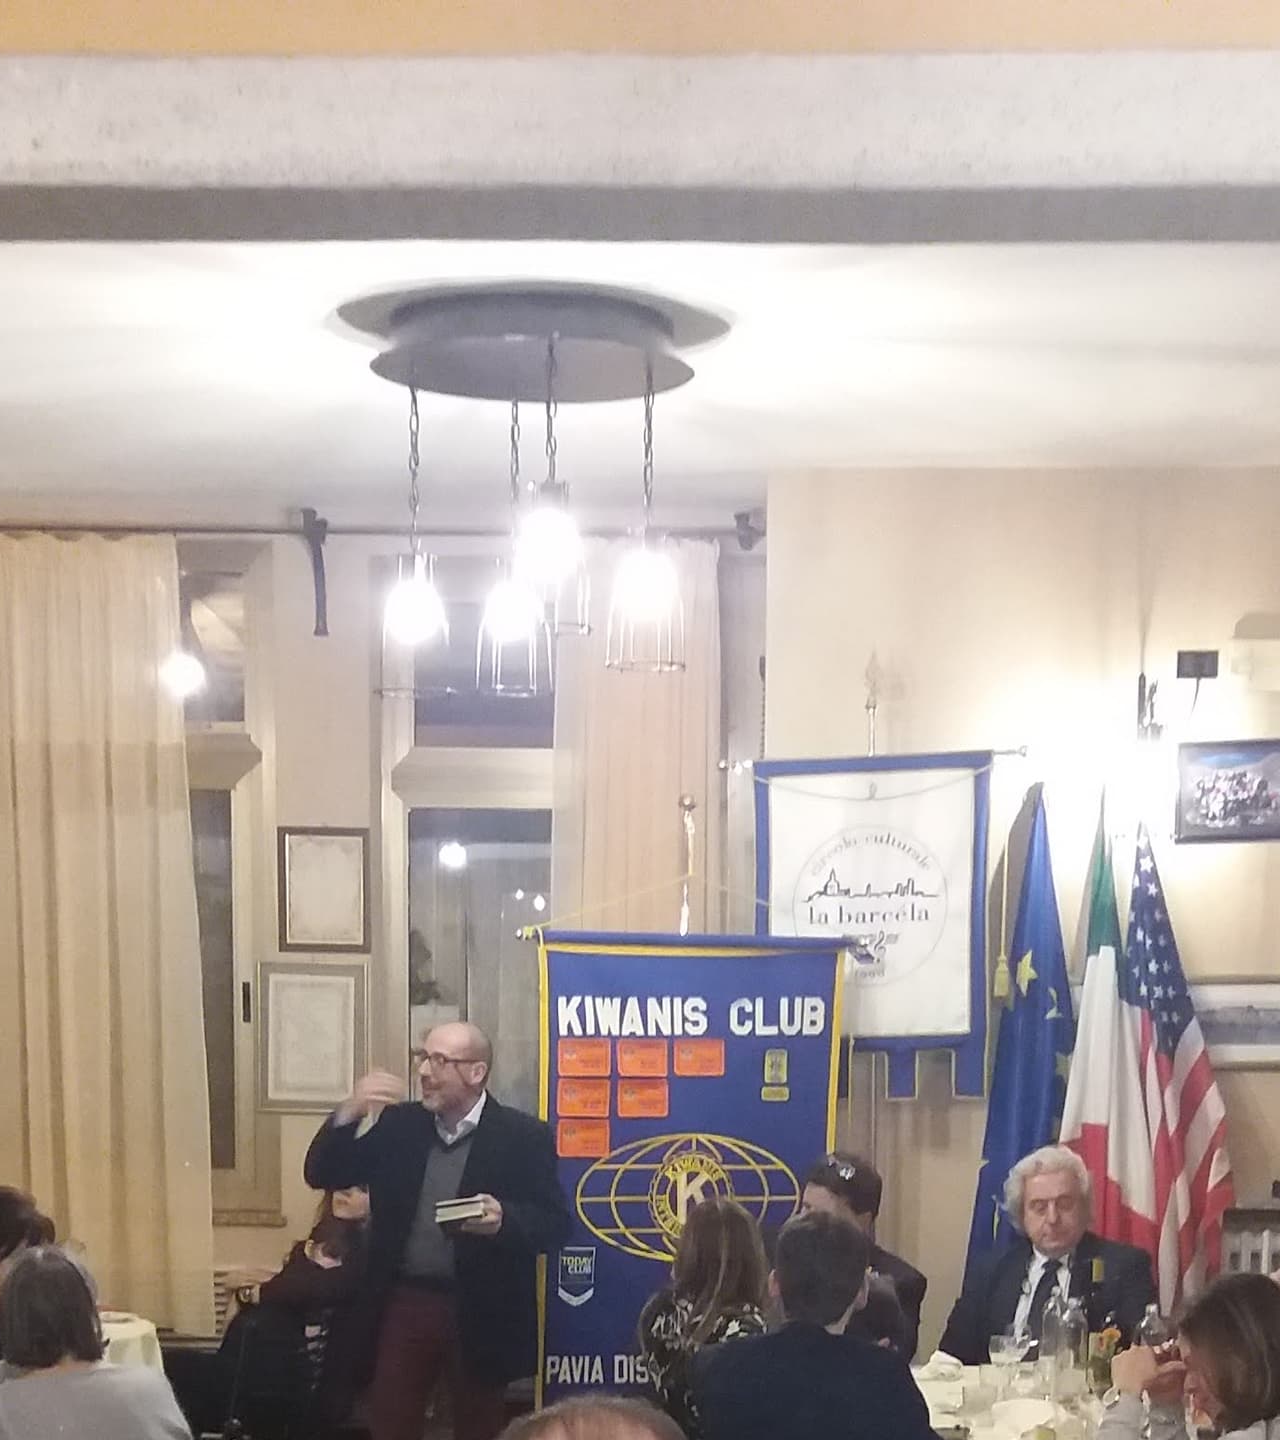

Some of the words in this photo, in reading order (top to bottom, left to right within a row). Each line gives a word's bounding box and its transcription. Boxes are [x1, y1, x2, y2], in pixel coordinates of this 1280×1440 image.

[809, 906, 829, 924] la
[557, 996, 708, 1036] KIWANIS
[729, 997, 825, 1036] CLUB
[561, 1256, 593, 1267] TODAY
[545, 1355, 604, 1385] PAVIA
